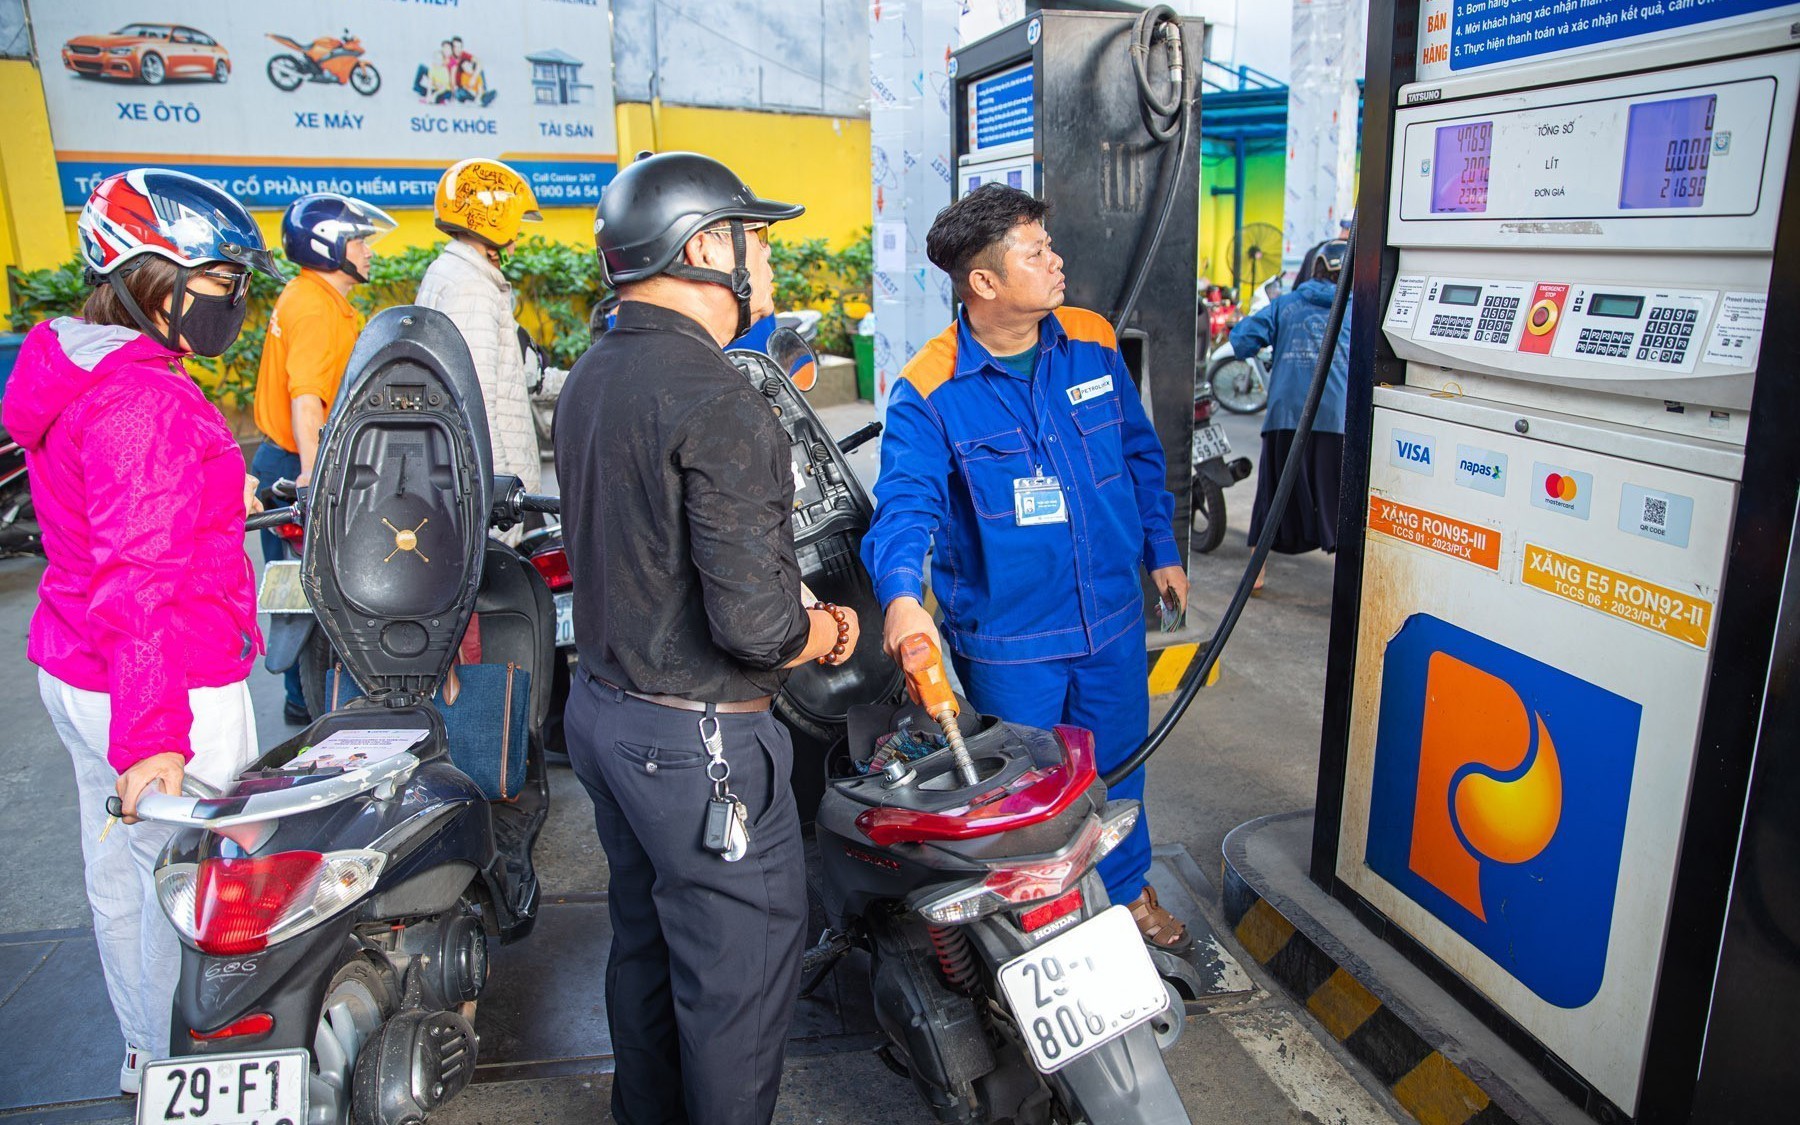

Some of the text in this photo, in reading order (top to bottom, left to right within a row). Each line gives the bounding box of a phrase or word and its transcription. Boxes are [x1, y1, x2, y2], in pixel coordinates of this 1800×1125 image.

[1456, 26, 1462, 36] 4.
[1465, 22, 1480, 35] Mời
[1483, 16, 1507, 30] khách
[1510, 12, 1532, 24] hàng
[1535, 6, 1550, 18] xác
[1554, 1, 1577, 14] nhận
[1457, 6, 1464, 16] 3.
[1466, 3, 1486, 14] Bơm
[1428, 10, 1447, 32] BÁN
[1455, 46, 1461, 56] 5.
[1464, 43, 1484, 55] Thực
[1487, 38, 1504, 50] hiện
[1507, 31, 1531, 45] thanh
[1535, 26, 1554, 39] toán
[1558, 22, 1568, 34] và
[1571, 19, 1589, 32] xác
[1592, 12, 1617, 27] nhận
[1621, 5, 1637, 21] kết
[1641, 1, 1664, 20] quả,
[1030, 24, 1039, 40] 27
[1423, 43, 1448, 64] HÀNG
[1408, 90, 1440, 102] TATSUNO
[117, 101, 200, 123] XE ÔTÔ
[295, 111, 364, 130] XE MÁY
[410, 114, 497, 134] SỨC KHỎE
[539, 122, 561, 137] TÀI
[1545, 156, 1559, 169] LÍT
[264, 176, 312, 195] PHẦN
[316, 177, 350, 195] BẢO
[532, 173, 549, 182] Call
[550, 173, 577, 182] Center
[534, 185, 563, 197] 1900
[566, 185, 581, 197] 54
[584, 185, 599, 197] 54
[1552, 186, 1565, 197] GIÁ
[1661, 177, 1706, 198] 21690
[1653, 309, 1659, 318] 7
[1664, 310, 1670, 319] 8
[1676, 311, 1683, 319] 9
[1496, 322, 1501, 330] 3
[1648, 323, 1654, 331] 4
[1659, 324, 1666, 332] 5
[1672, 325, 1678, 333] 6
[1645, 336, 1649, 345] 1
[1655, 337, 1662, 346] 2
[1667, 338, 1673, 347] 3
[1640, 350, 1646, 358] 0
[1651, 351, 1658, 359] C
[1395, 440, 1430, 464] VISA
[1460, 459, 1491, 476] napas
[1545, 498, 1574, 510] mastercard
[1381, 505, 1486, 550] XĂNG RON95-III
[1640, 524, 1665, 536] QR CODE
[1392, 525, 1414, 541] TCCS
[1416, 533, 1424, 543] 01
[1432, 538, 1471, 559] 2023/PLX
[1530, 552, 1703, 627] XĂNG E5 RON92-II
[1555, 580, 1584, 600] TCCS
[1588, 593, 1600, 606] 06
[1611, 600, 1667, 630] 2023/PLX
[1034, 915, 1077, 940] HONDA
[164, 1060, 280, 1120] 29-F1
